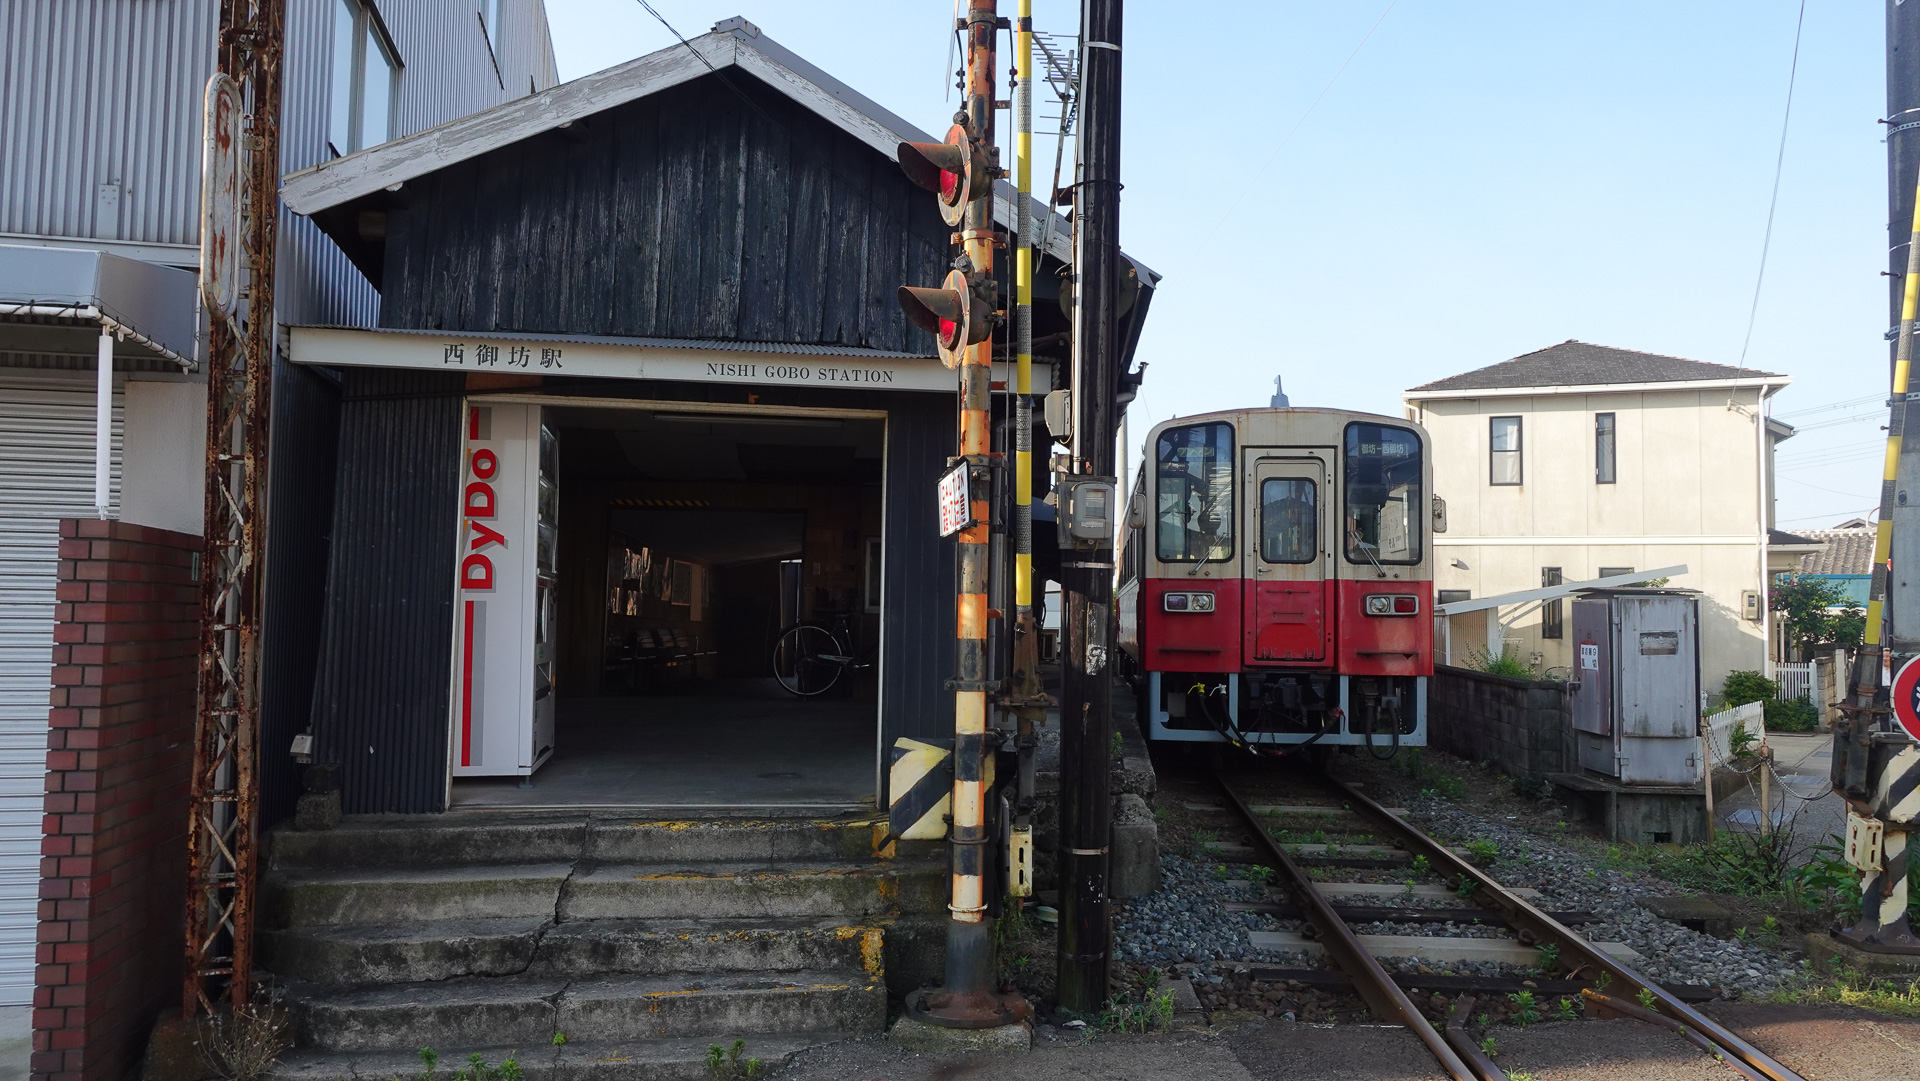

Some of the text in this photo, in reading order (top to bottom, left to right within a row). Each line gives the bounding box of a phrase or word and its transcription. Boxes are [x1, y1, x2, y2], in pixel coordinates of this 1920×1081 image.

[443, 343, 564, 369] 西御坊駅
[706, 363, 894, 384] NISHI GOBO STATION
[461, 448, 506, 590] DyDo
